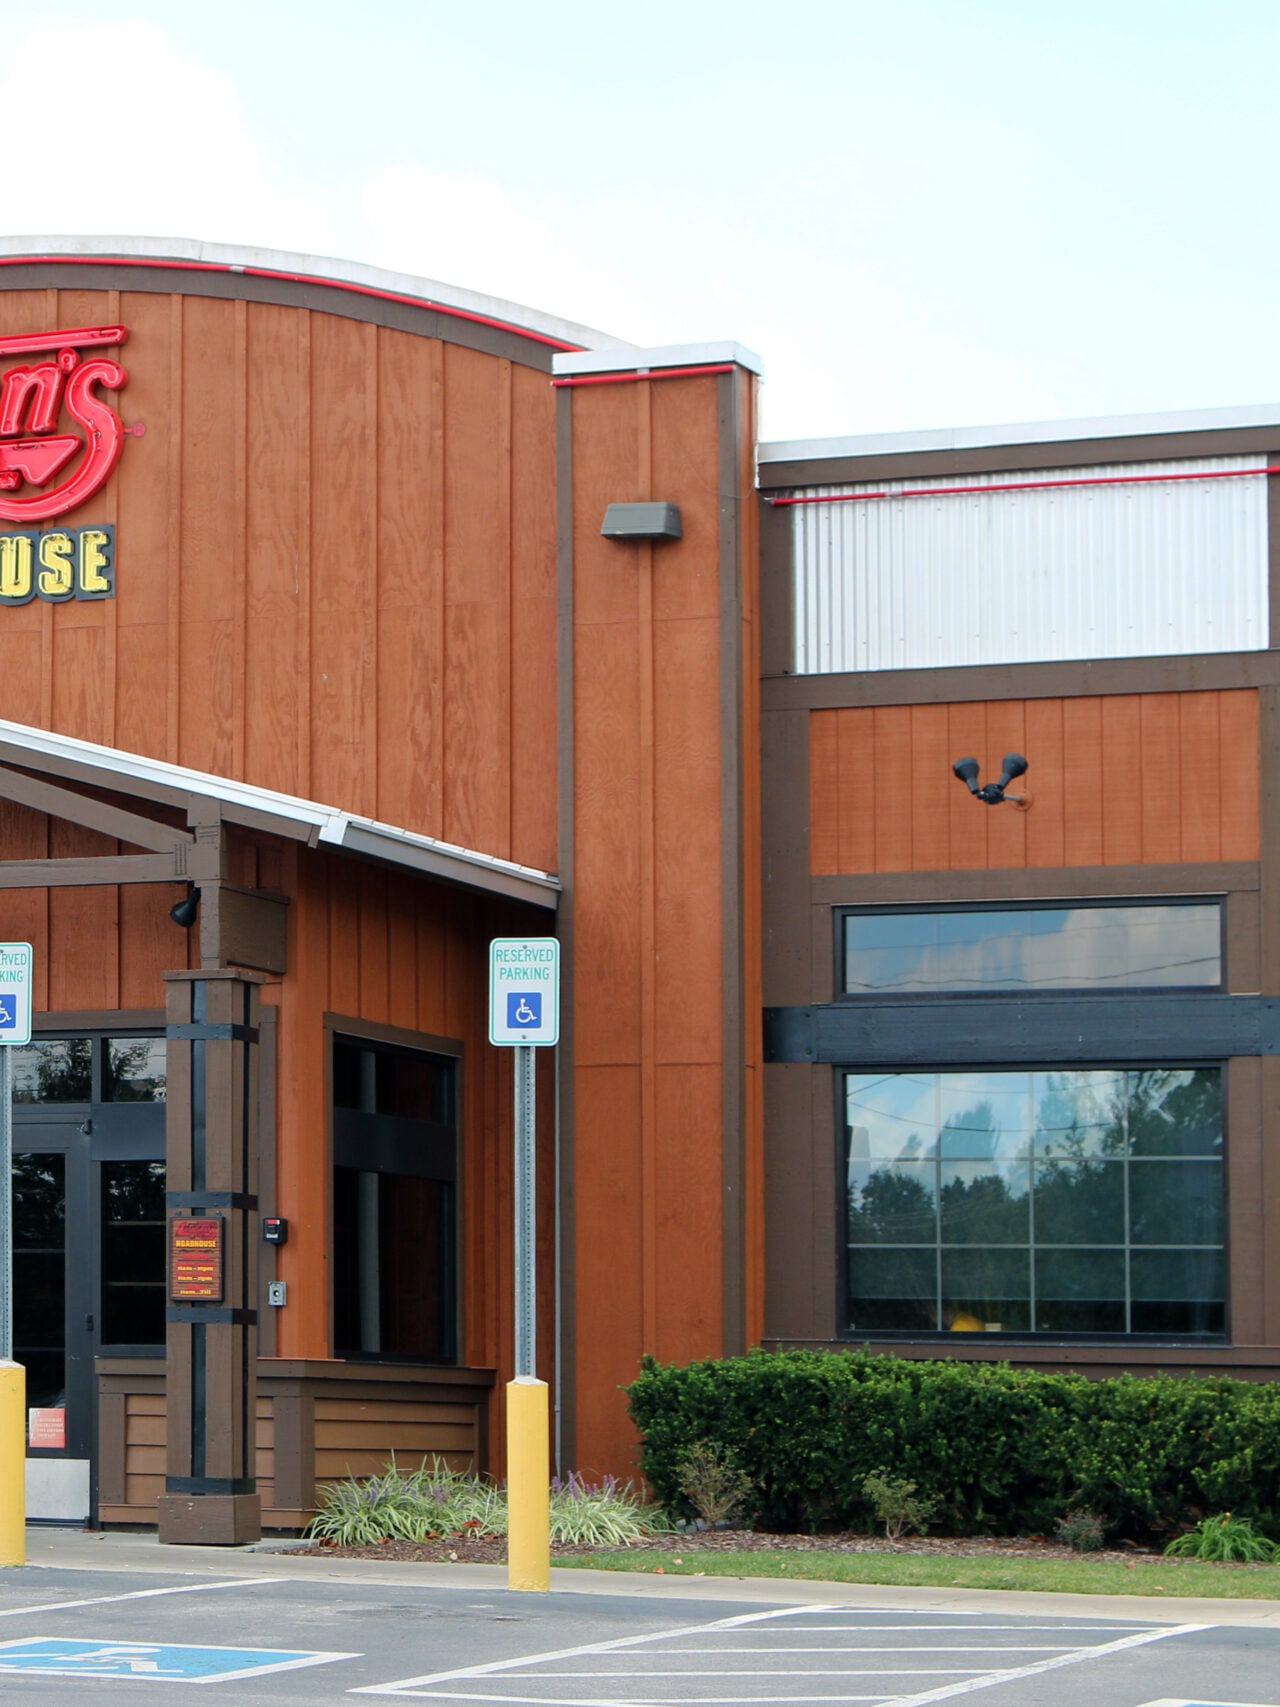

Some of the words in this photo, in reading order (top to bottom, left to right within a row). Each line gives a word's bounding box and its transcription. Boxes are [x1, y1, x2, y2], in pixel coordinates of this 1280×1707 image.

[496, 948, 554, 962] RESERVED
[500, 967, 550, 981] PARKING
[175, 1240, 217, 1248] ROADHOUSE
